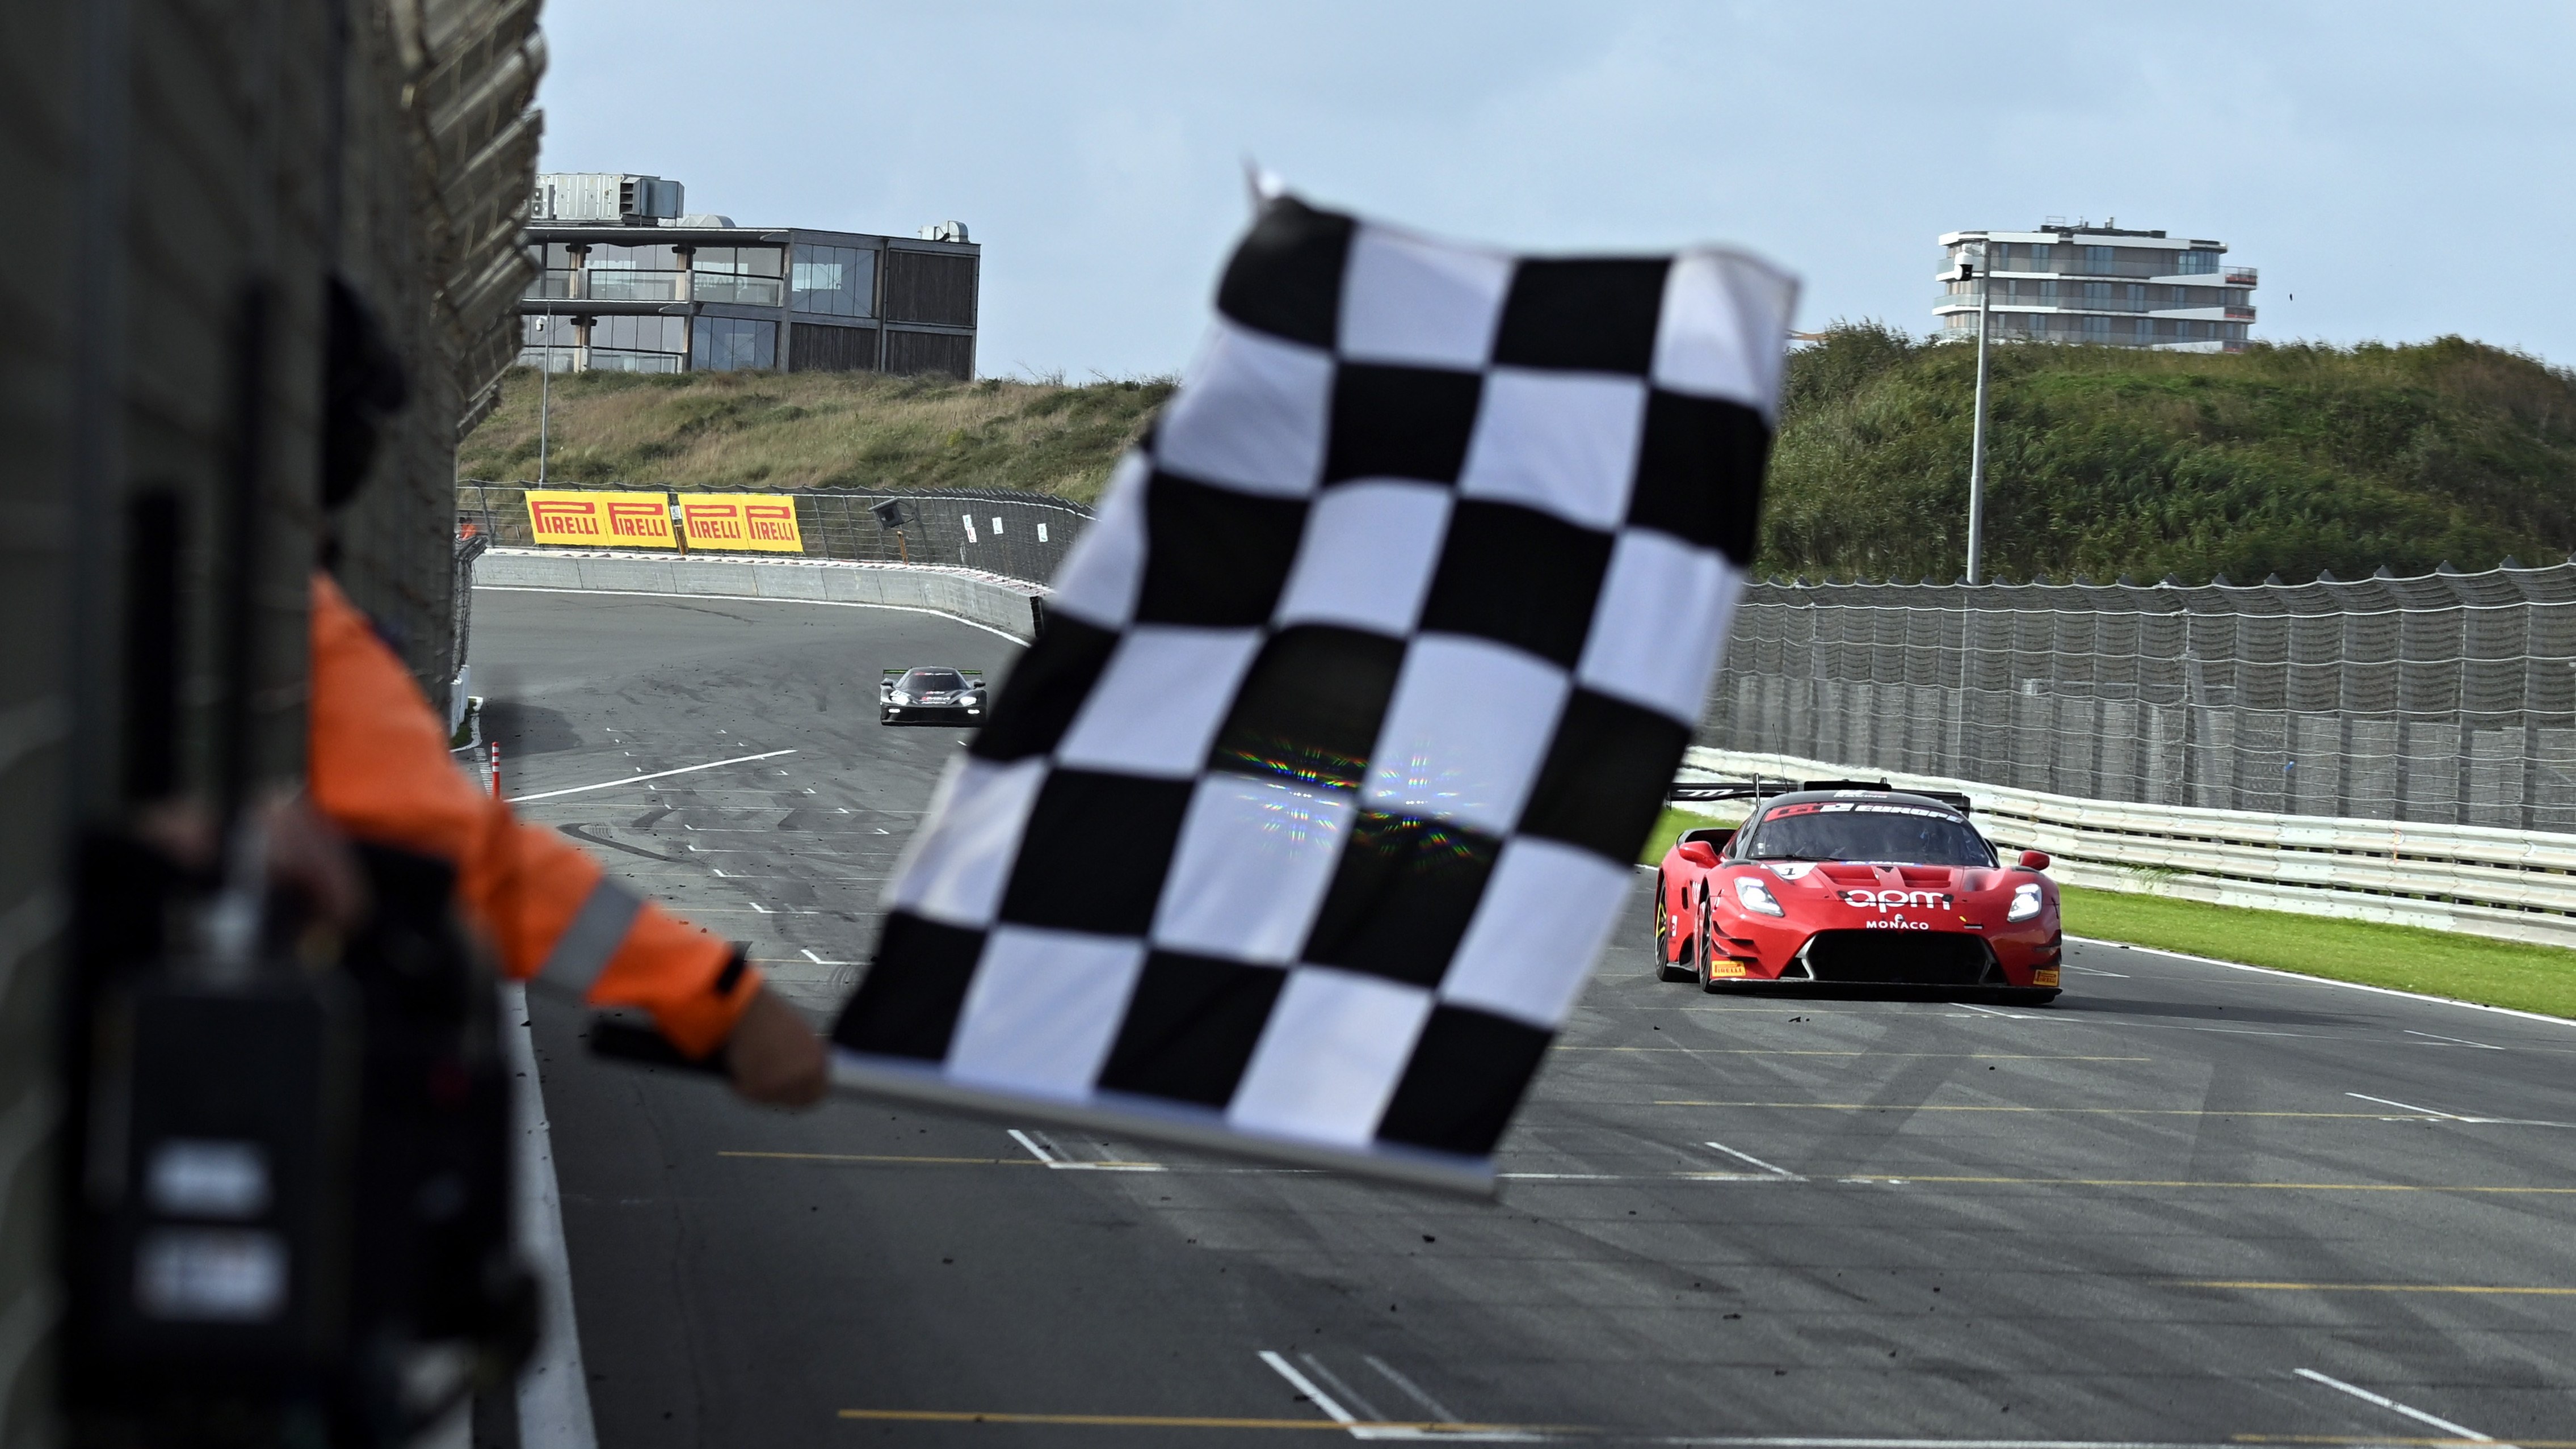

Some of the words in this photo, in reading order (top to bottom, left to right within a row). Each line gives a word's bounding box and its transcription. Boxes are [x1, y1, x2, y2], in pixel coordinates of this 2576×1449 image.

[531, 501, 599, 535] PIRELLI
[607, 503, 667, 537] PIRELLI
[684, 504, 741, 539] PIRELLI
[745, 506, 795, 541] PIRELLI
[1855, 805, 1964, 824] EUROPE
[1844, 889, 1951, 913] apm
[1866, 920, 1930, 930] MONACO
[1714, 963, 1742, 973] PIRELLI
